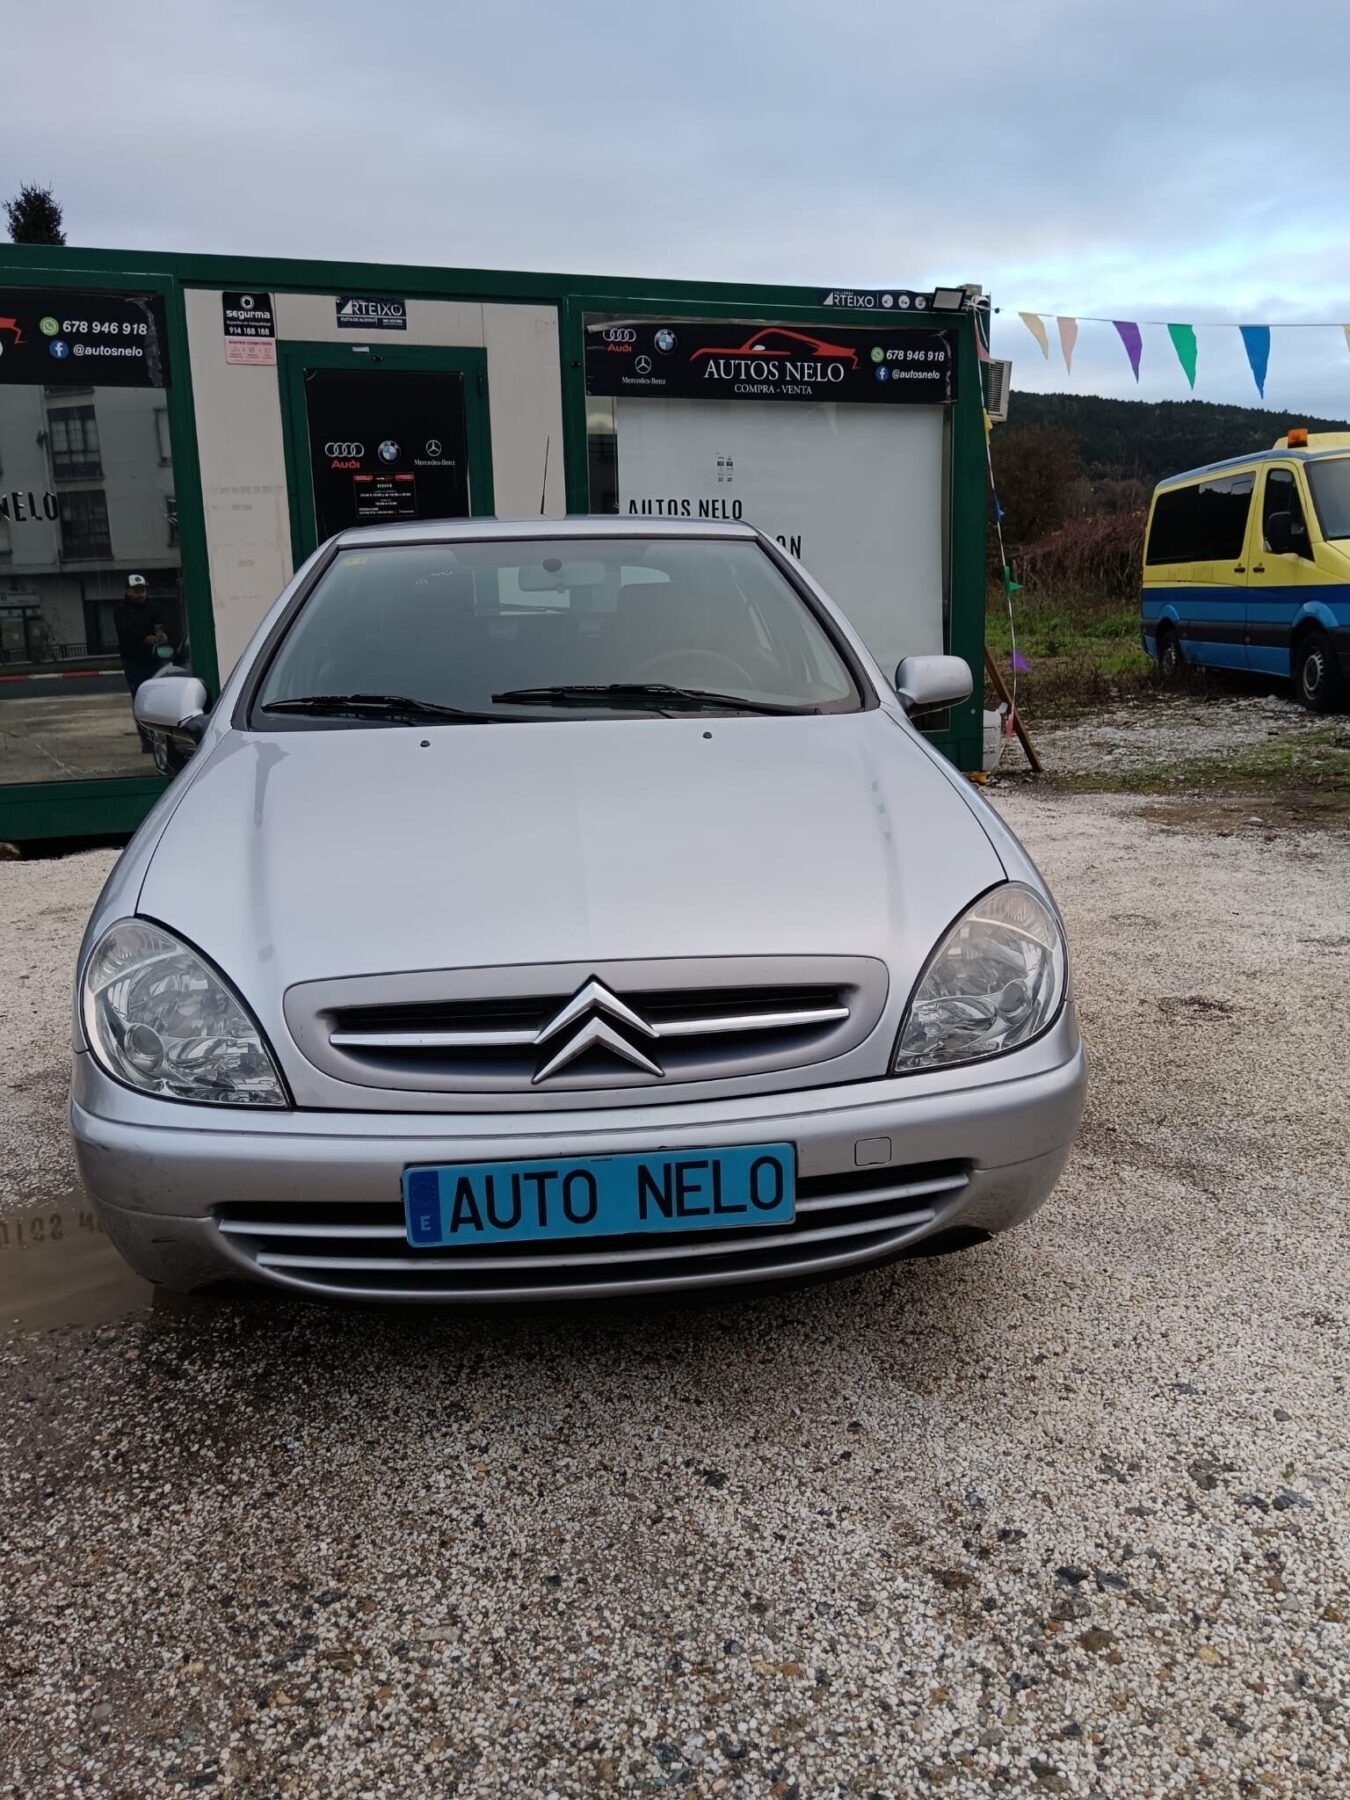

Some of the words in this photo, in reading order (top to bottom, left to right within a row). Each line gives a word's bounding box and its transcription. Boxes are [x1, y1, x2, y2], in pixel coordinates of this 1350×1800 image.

[226, 310, 271, 320] segurma
[63, 321, 88, 334] 678
[92, 322, 118, 334] 946
[122, 322, 147, 335] 918
[73, 344, 143, 357] @autosnelo
[607, 343, 632, 353] Audi
[886, 349, 904, 360] 678
[905, 350, 925, 361] 946
[927, 351, 945, 362] 918
[704, 359, 778, 381] AUTOS
[785, 361, 845, 383] NELO
[892, 369, 940, 380] @autosnelo
[622, 376, 666, 385] Mercedes-Benz
[734, 384, 774, 394] COMPRA
[782, 385, 812, 395] VENTA
[331, 459, 361, 469] Audi
[628, 499, 691, 516] AUTOS
[698, 499, 743, 520] NELO
[450, 1168, 598, 1233] AUTO
[637, 1155, 784, 1220] NELO
[420, 1216, 431, 1230] E
